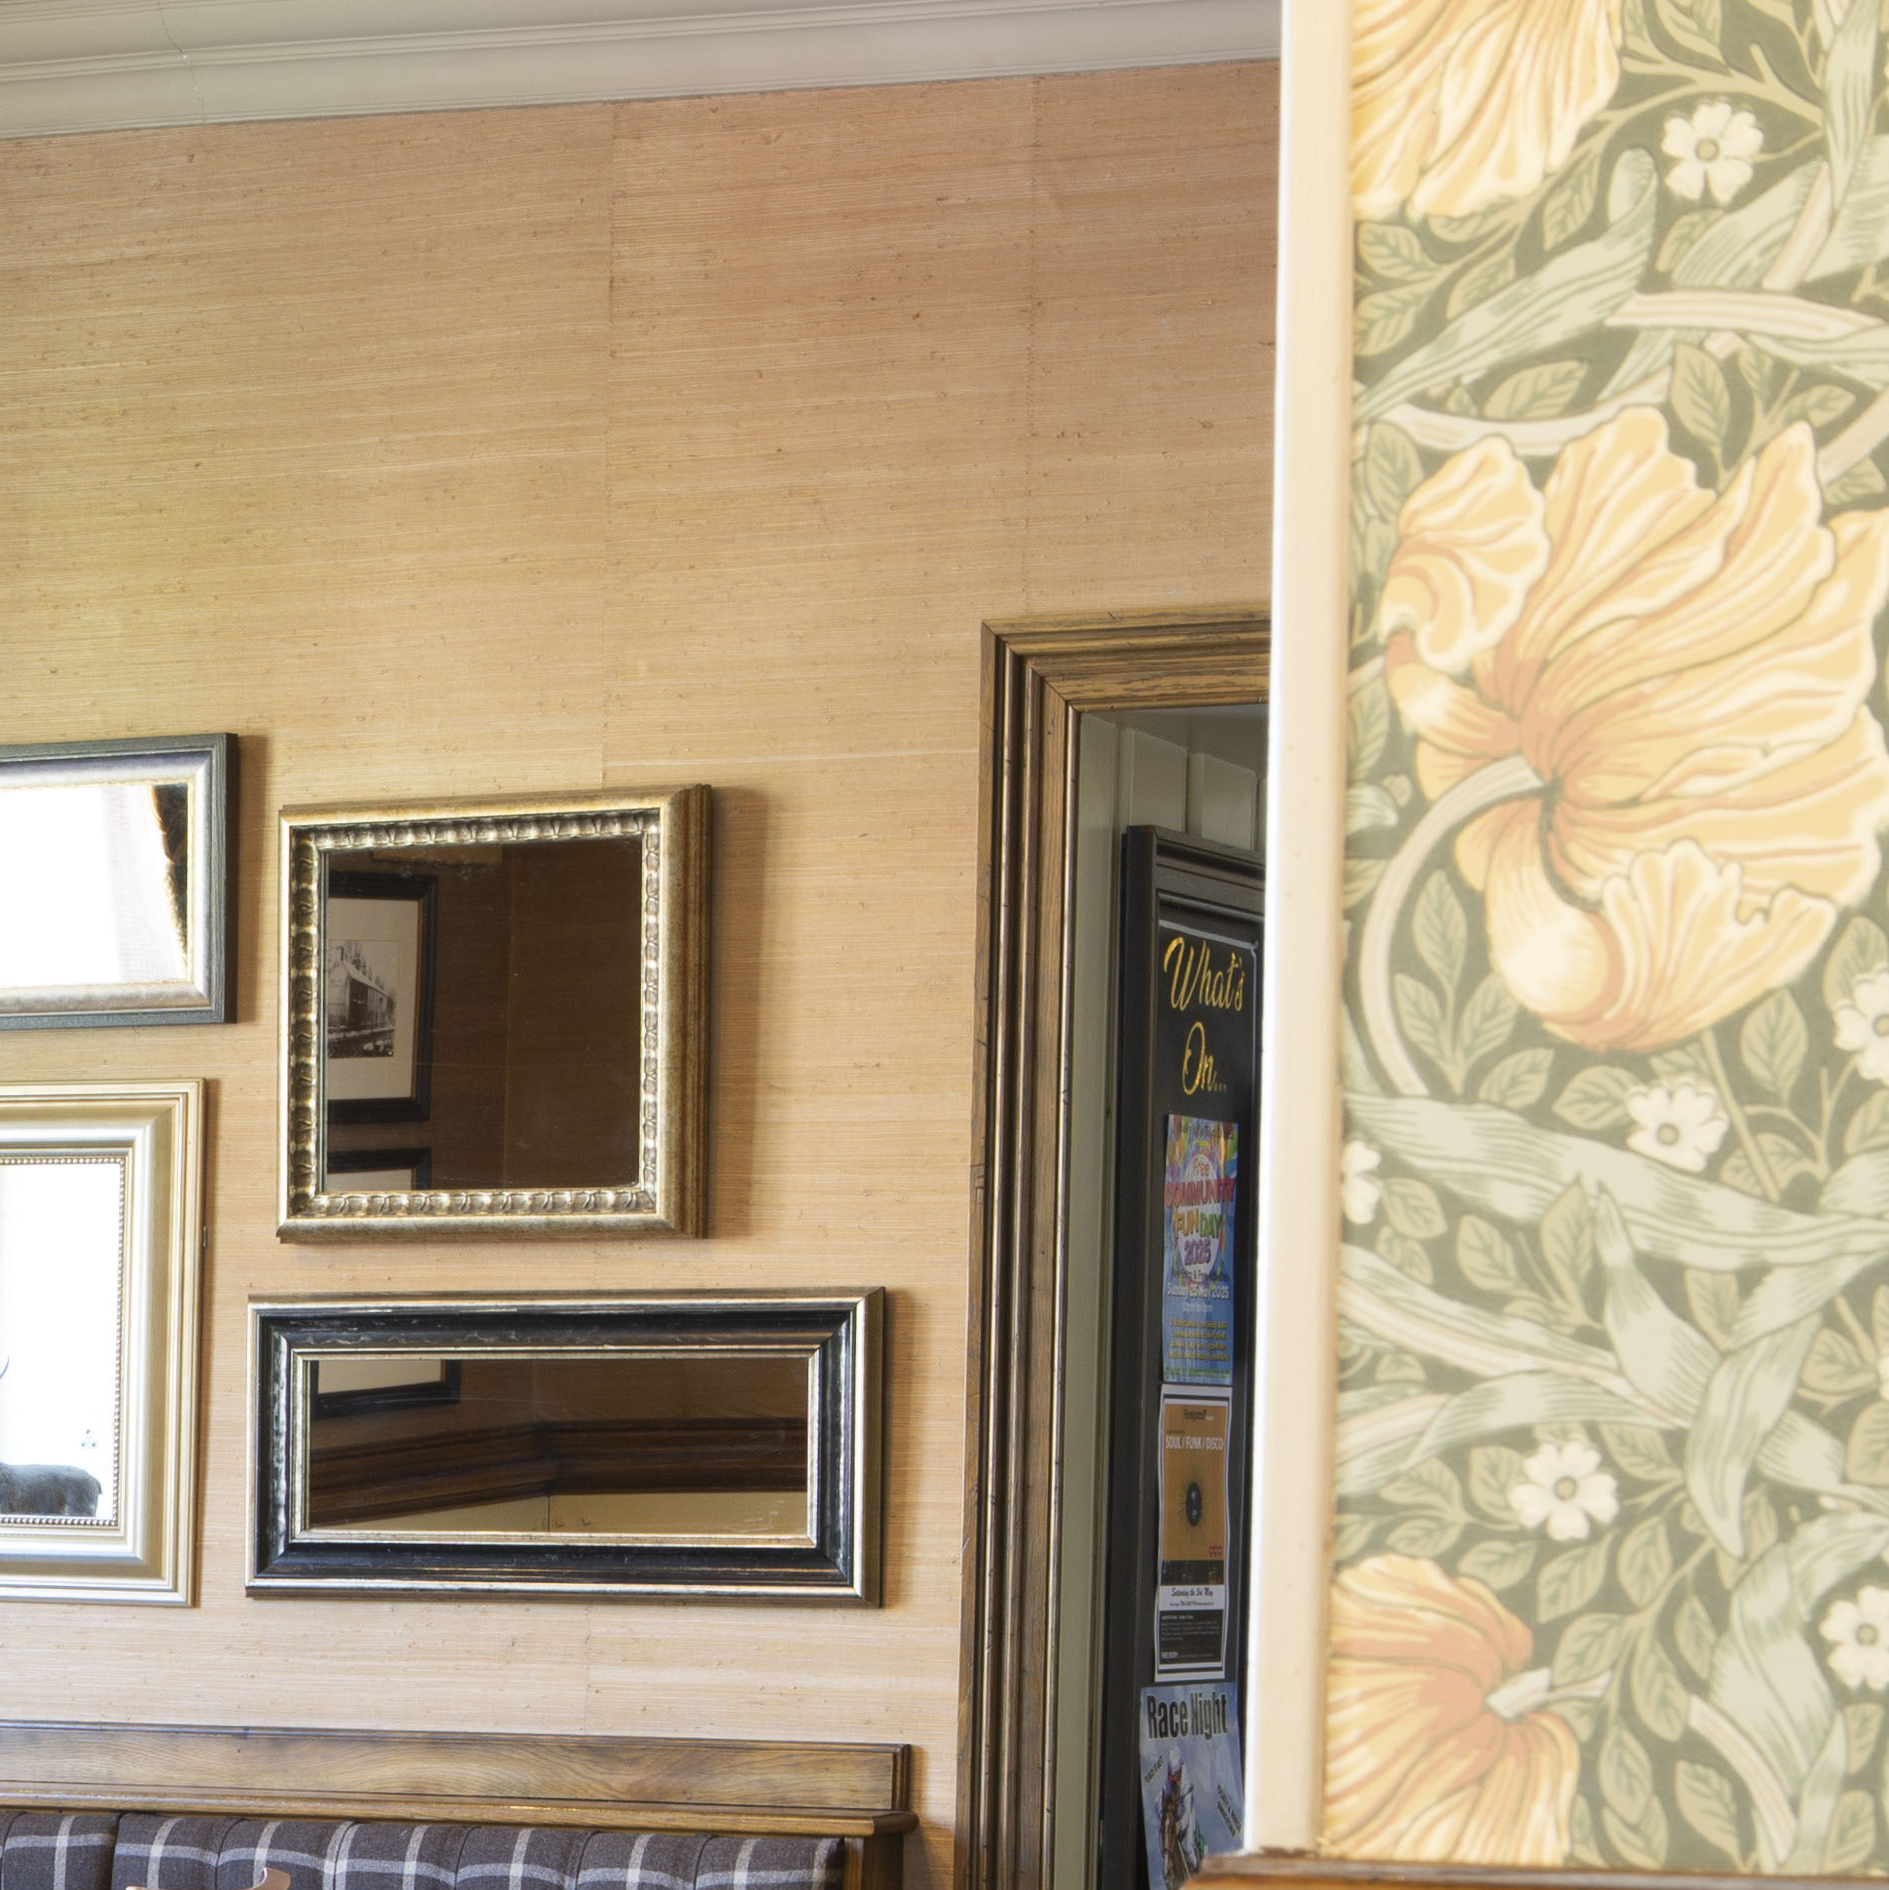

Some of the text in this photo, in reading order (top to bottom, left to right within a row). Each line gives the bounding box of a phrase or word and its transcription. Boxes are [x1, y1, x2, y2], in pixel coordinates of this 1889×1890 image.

[1163, 936, 1246, 1012] What's
[1165, 1179, 1236, 1208] COMMUNITY
[1173, 1208, 1223, 1239] FUN DAY
[1184, 1238, 1212, 1266] 2025
[1165, 1435, 1181, 1449] SOUL
[1185, 1436, 1202, 1449] FUNK
[1205, 1437, 1224, 1451] DISCO
[1146, 1692, 1228, 1740] Race Night
